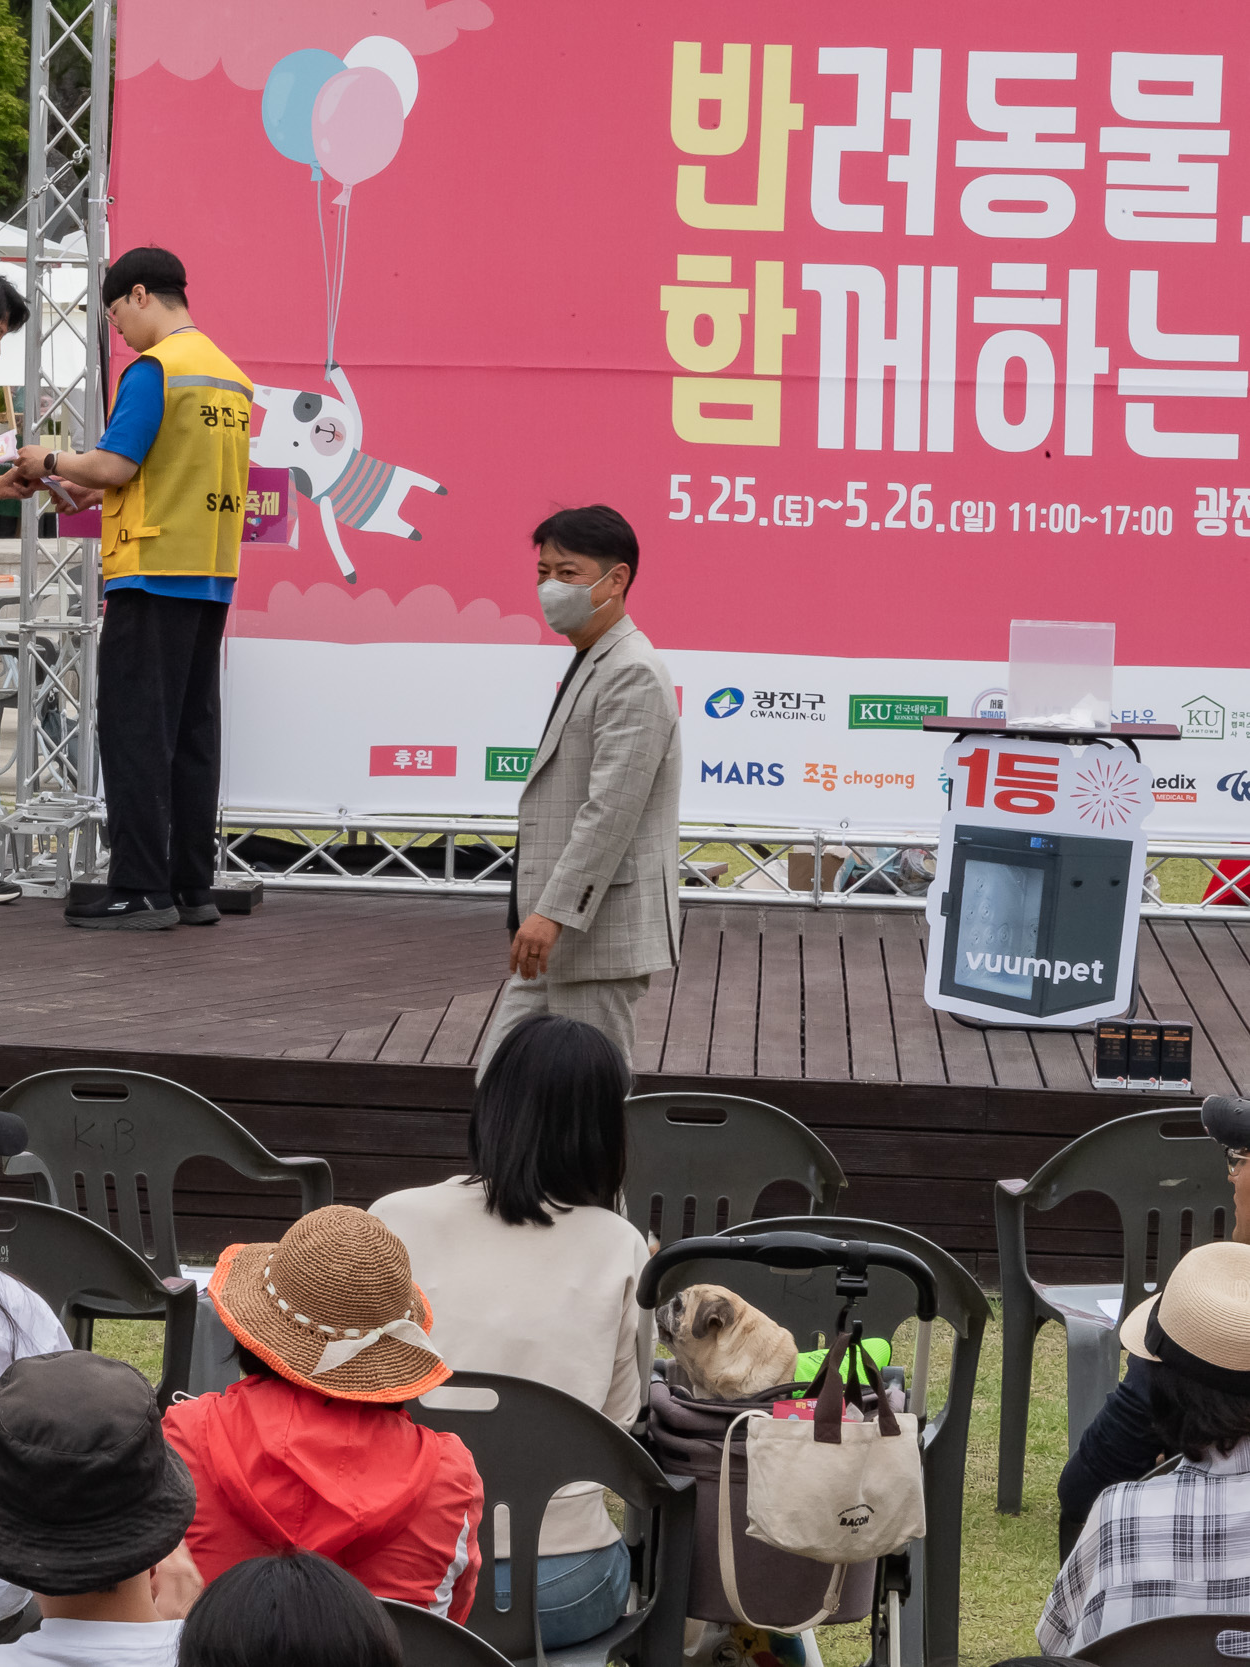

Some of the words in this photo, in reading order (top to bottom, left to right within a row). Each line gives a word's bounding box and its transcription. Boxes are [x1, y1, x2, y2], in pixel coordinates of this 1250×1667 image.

[669, 40, 1250, 244] 반려동물
[659, 253, 1249, 460] 함께하는
[199, 404, 250, 432] 광진구
[245, 490, 281, 517] 축제
[1008, 500, 1174, 536] 11:00~17:00
[752, 690, 826, 711] 광진구
[859, 703, 893, 721] KU
[893, 703, 938, 715] 건국대학교
[989, 699, 1004, 710] 서울
[749, 709, 827, 722] GWANGJIN-GU
[1186, 709, 1221, 727] KU
[393, 749, 433, 770] 후원
[496, 755, 527, 773] KU
[700, 760, 785, 787] MARS
[802, 762, 839, 792] 조공
[843, 769, 916, 790] chogong
[956, 747, 1061, 815] 1등
[965, 950, 1105, 985] vuumpet
[839, 1514, 870, 1528] BACON
